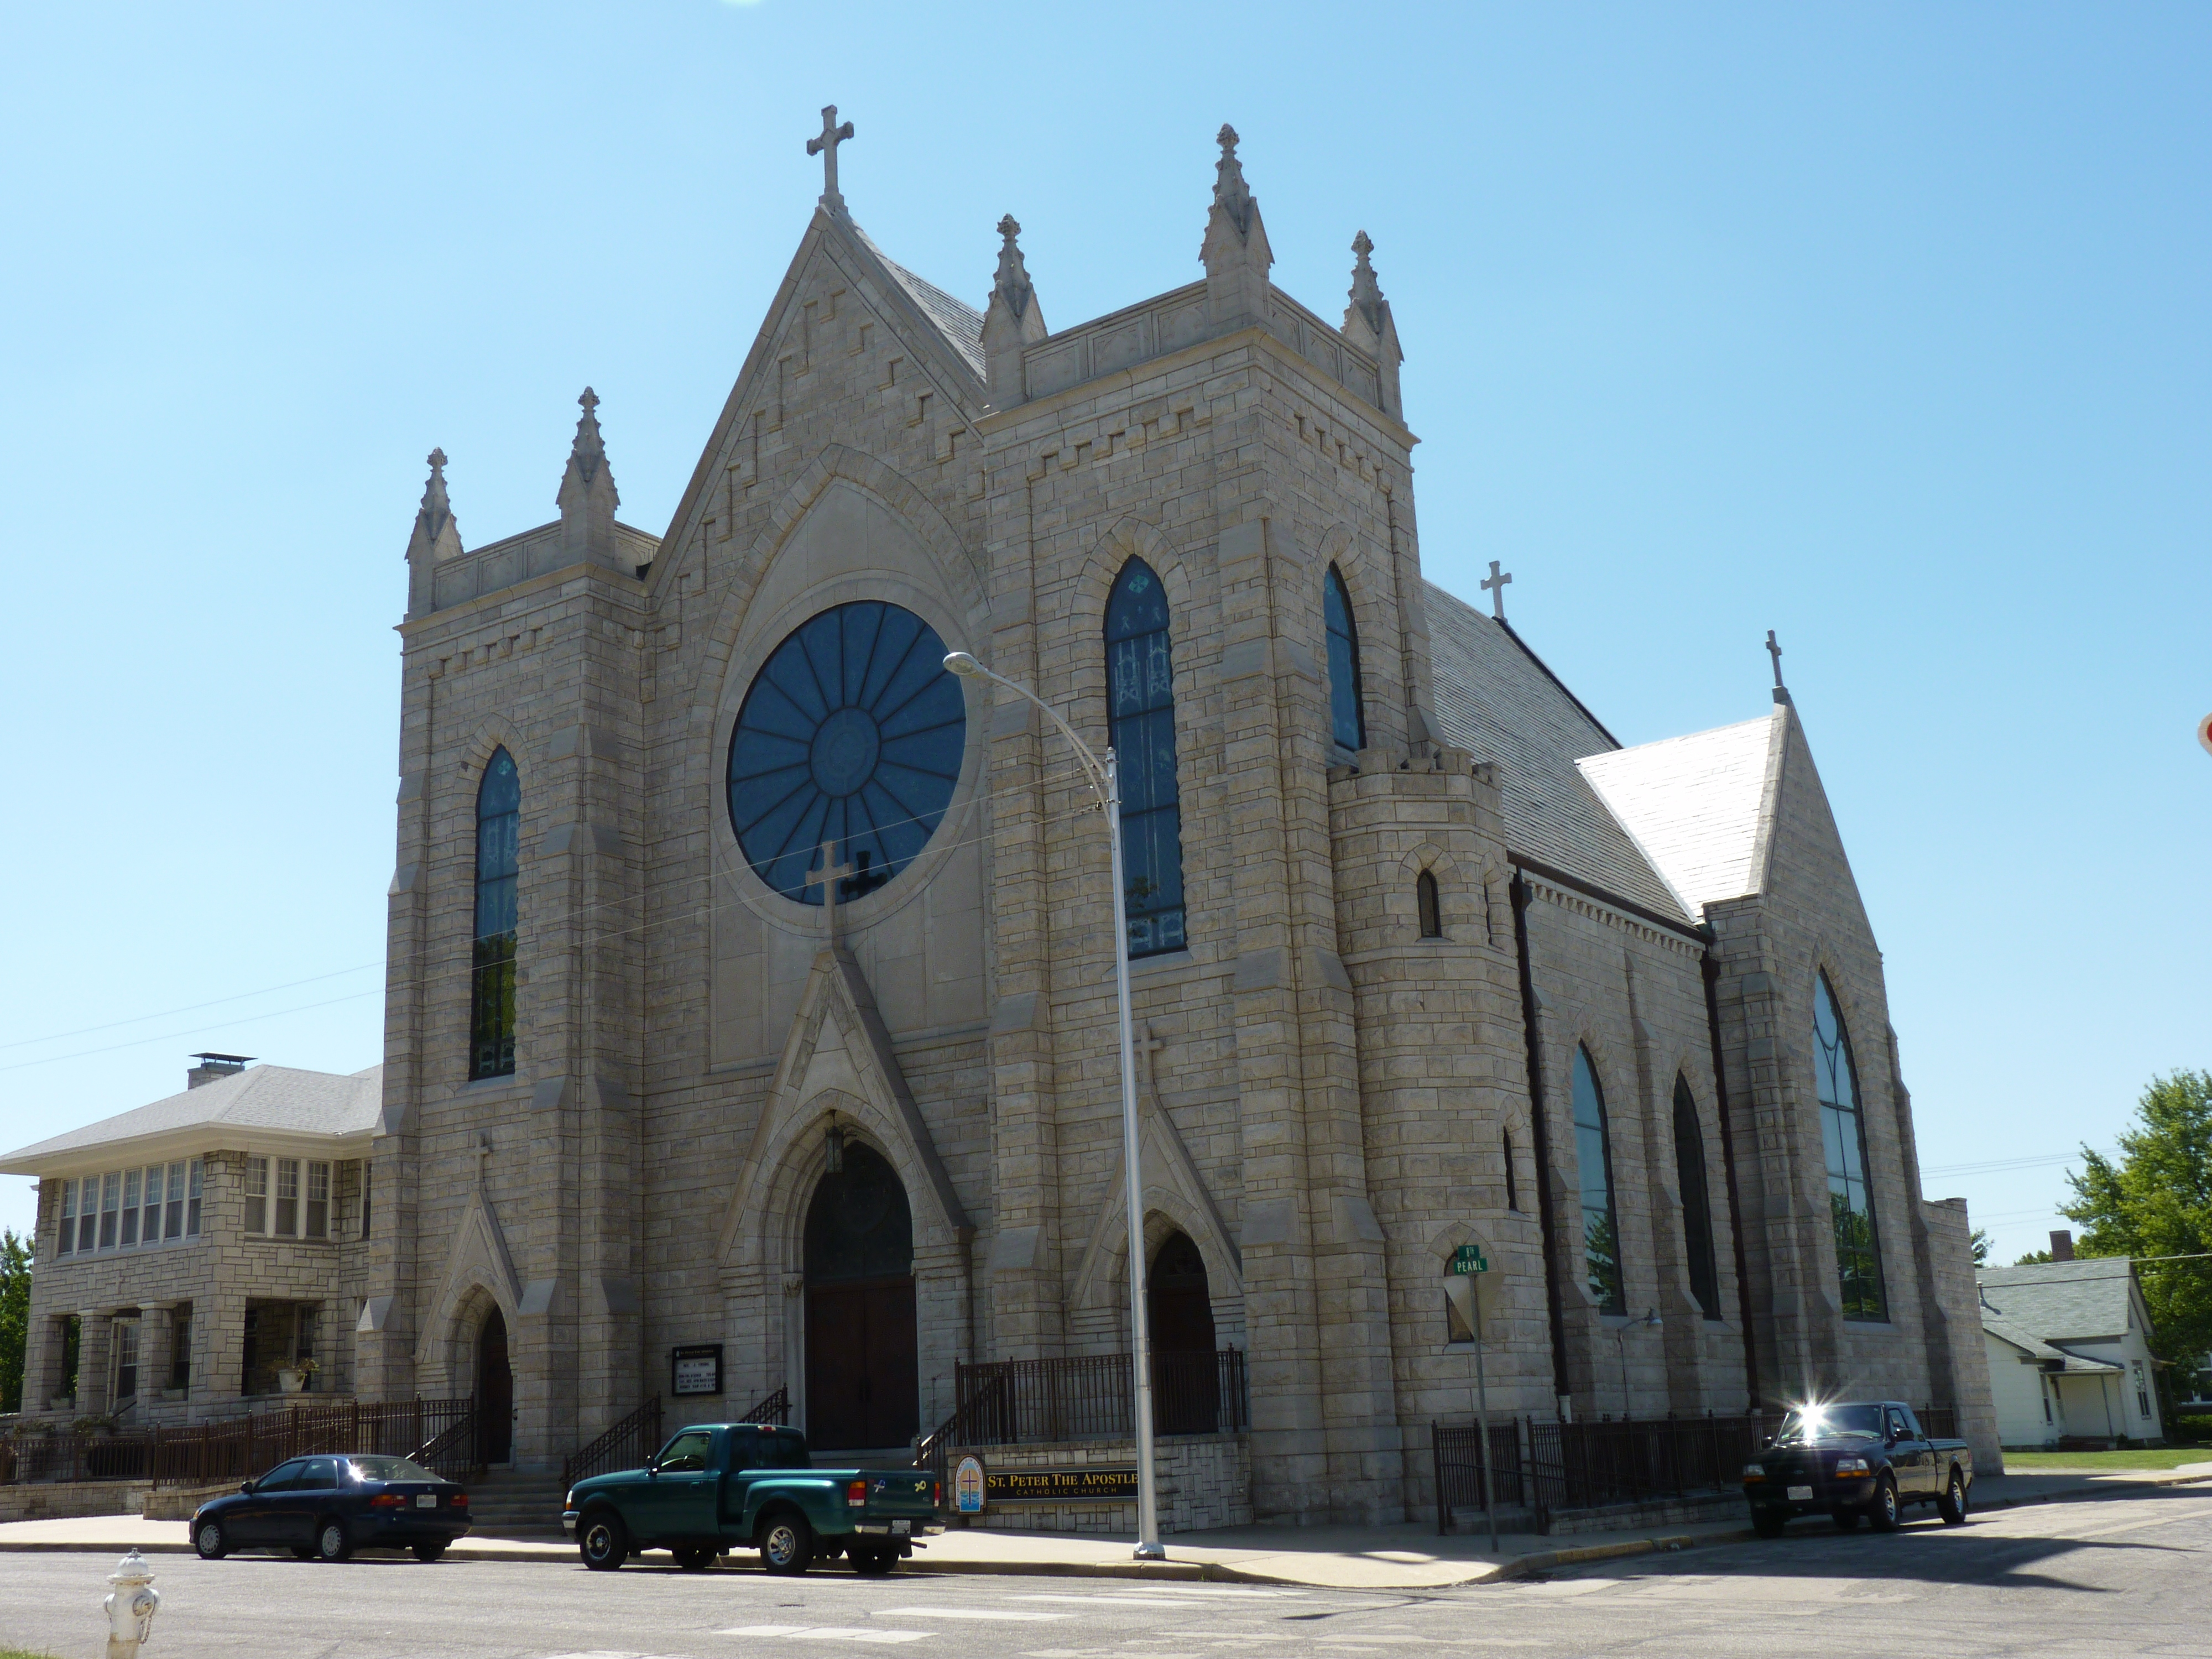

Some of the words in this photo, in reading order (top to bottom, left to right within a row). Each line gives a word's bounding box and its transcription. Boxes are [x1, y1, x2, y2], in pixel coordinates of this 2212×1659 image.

[1457, 1260, 1483, 1272] PEARL
[988, 1475, 1006, 1488] ST.
[1010, 1475, 1049, 1487] PETER
[1052, 1474, 1078, 1485] THE
[1082, 1473, 1138, 1485] APOSTLE
